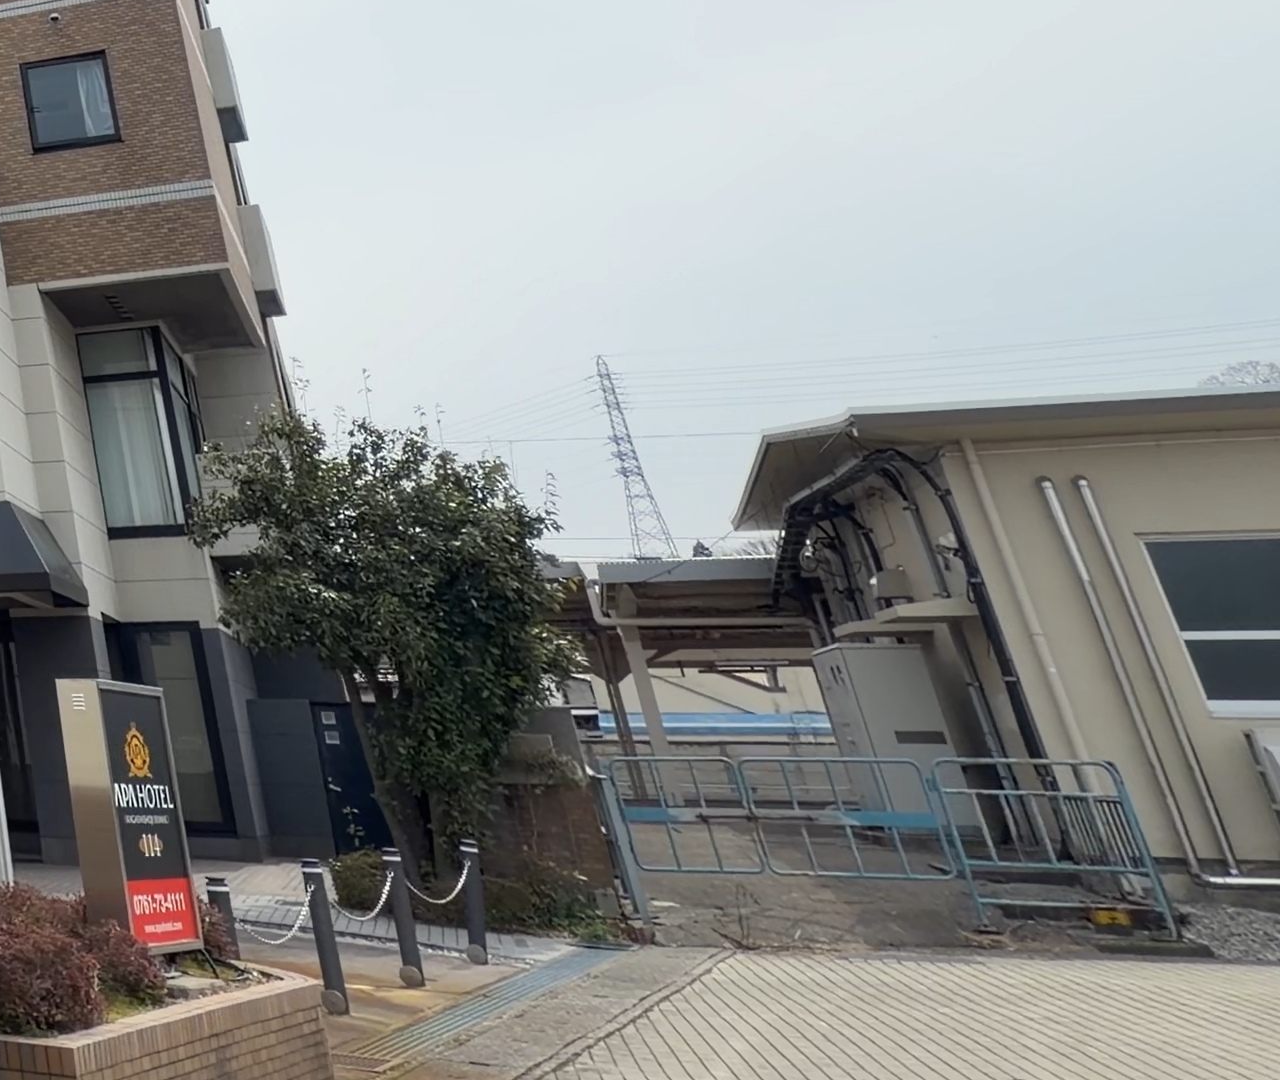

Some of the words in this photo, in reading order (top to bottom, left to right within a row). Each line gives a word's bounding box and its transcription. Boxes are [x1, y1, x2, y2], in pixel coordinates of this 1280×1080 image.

[114, 783, 138, 808] APA
[136, 784, 174, 808] HOTEL
[142, 833, 162, 857] 114
[133, 892, 186, 915] 0761-73-4111
